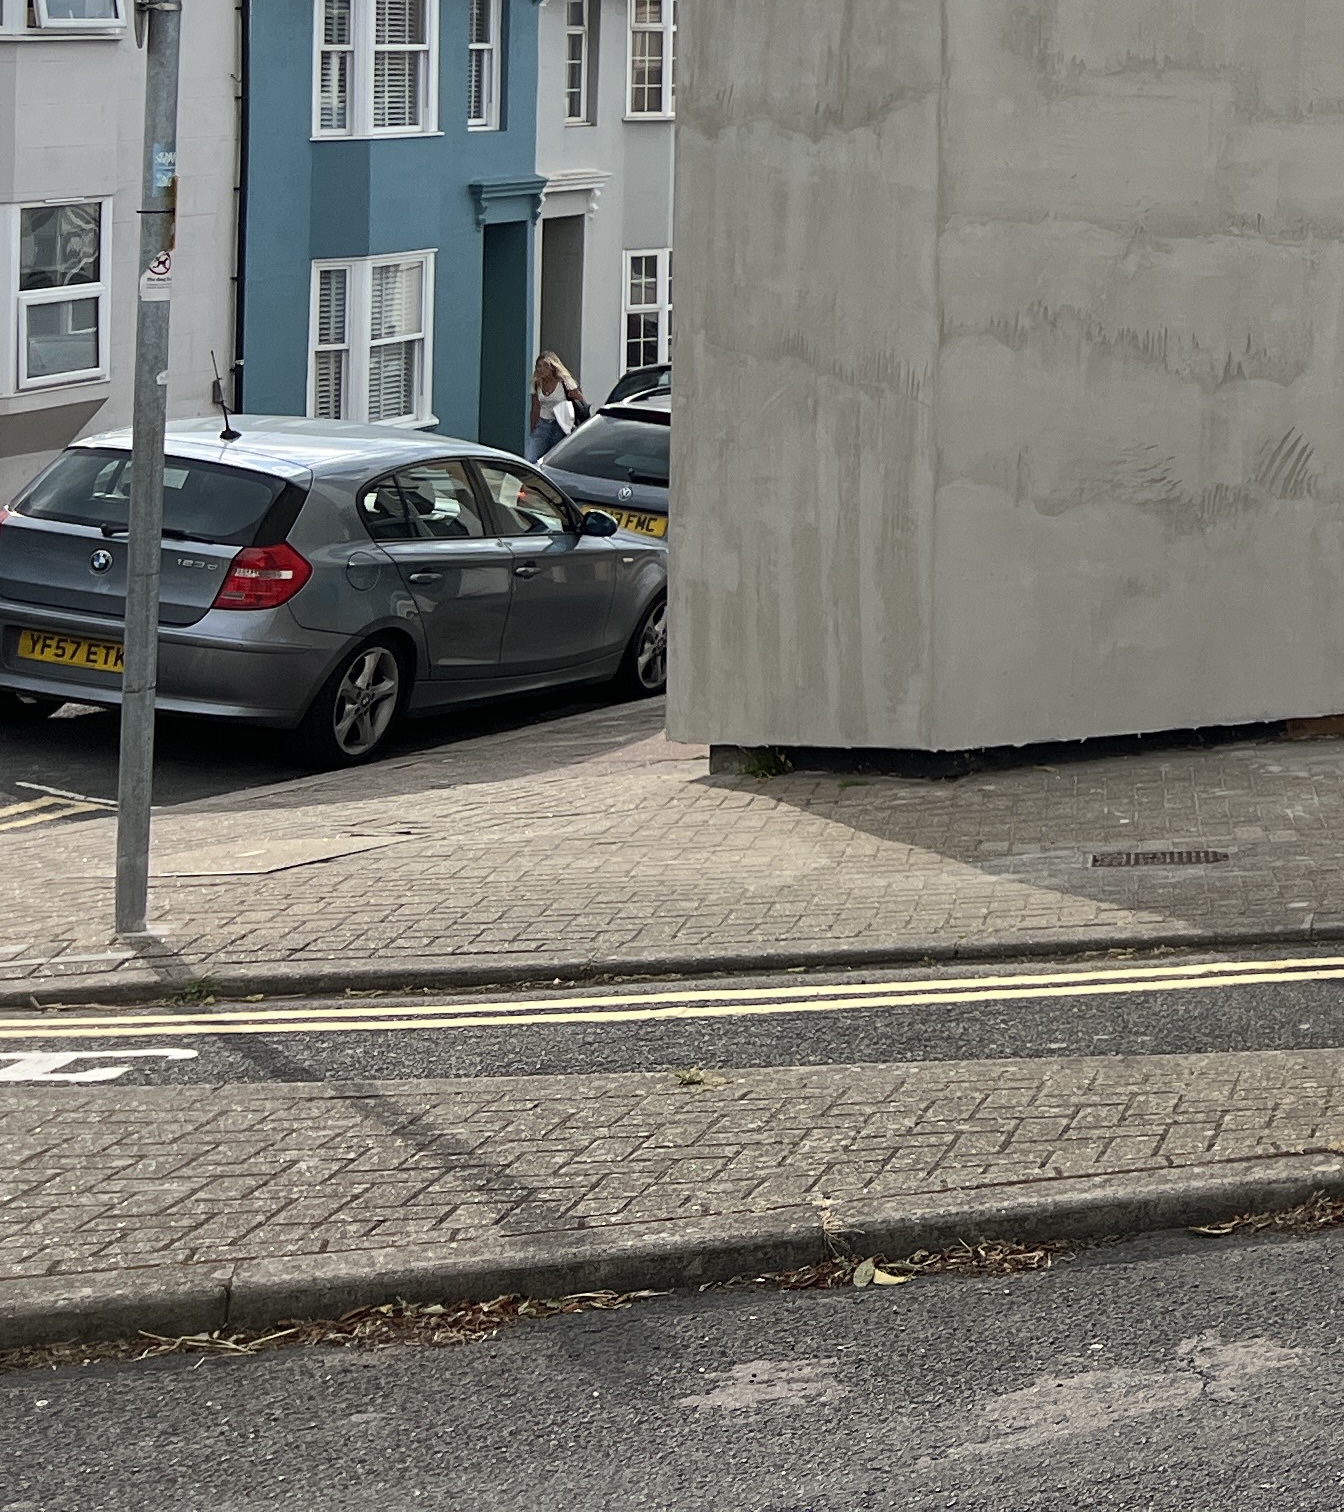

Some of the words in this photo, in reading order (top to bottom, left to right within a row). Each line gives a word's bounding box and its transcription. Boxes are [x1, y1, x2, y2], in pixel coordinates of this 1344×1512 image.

[624, 513, 658, 533] FMC
[29, 633, 82, 661] YF57
[86, 642, 125, 668] ETK
